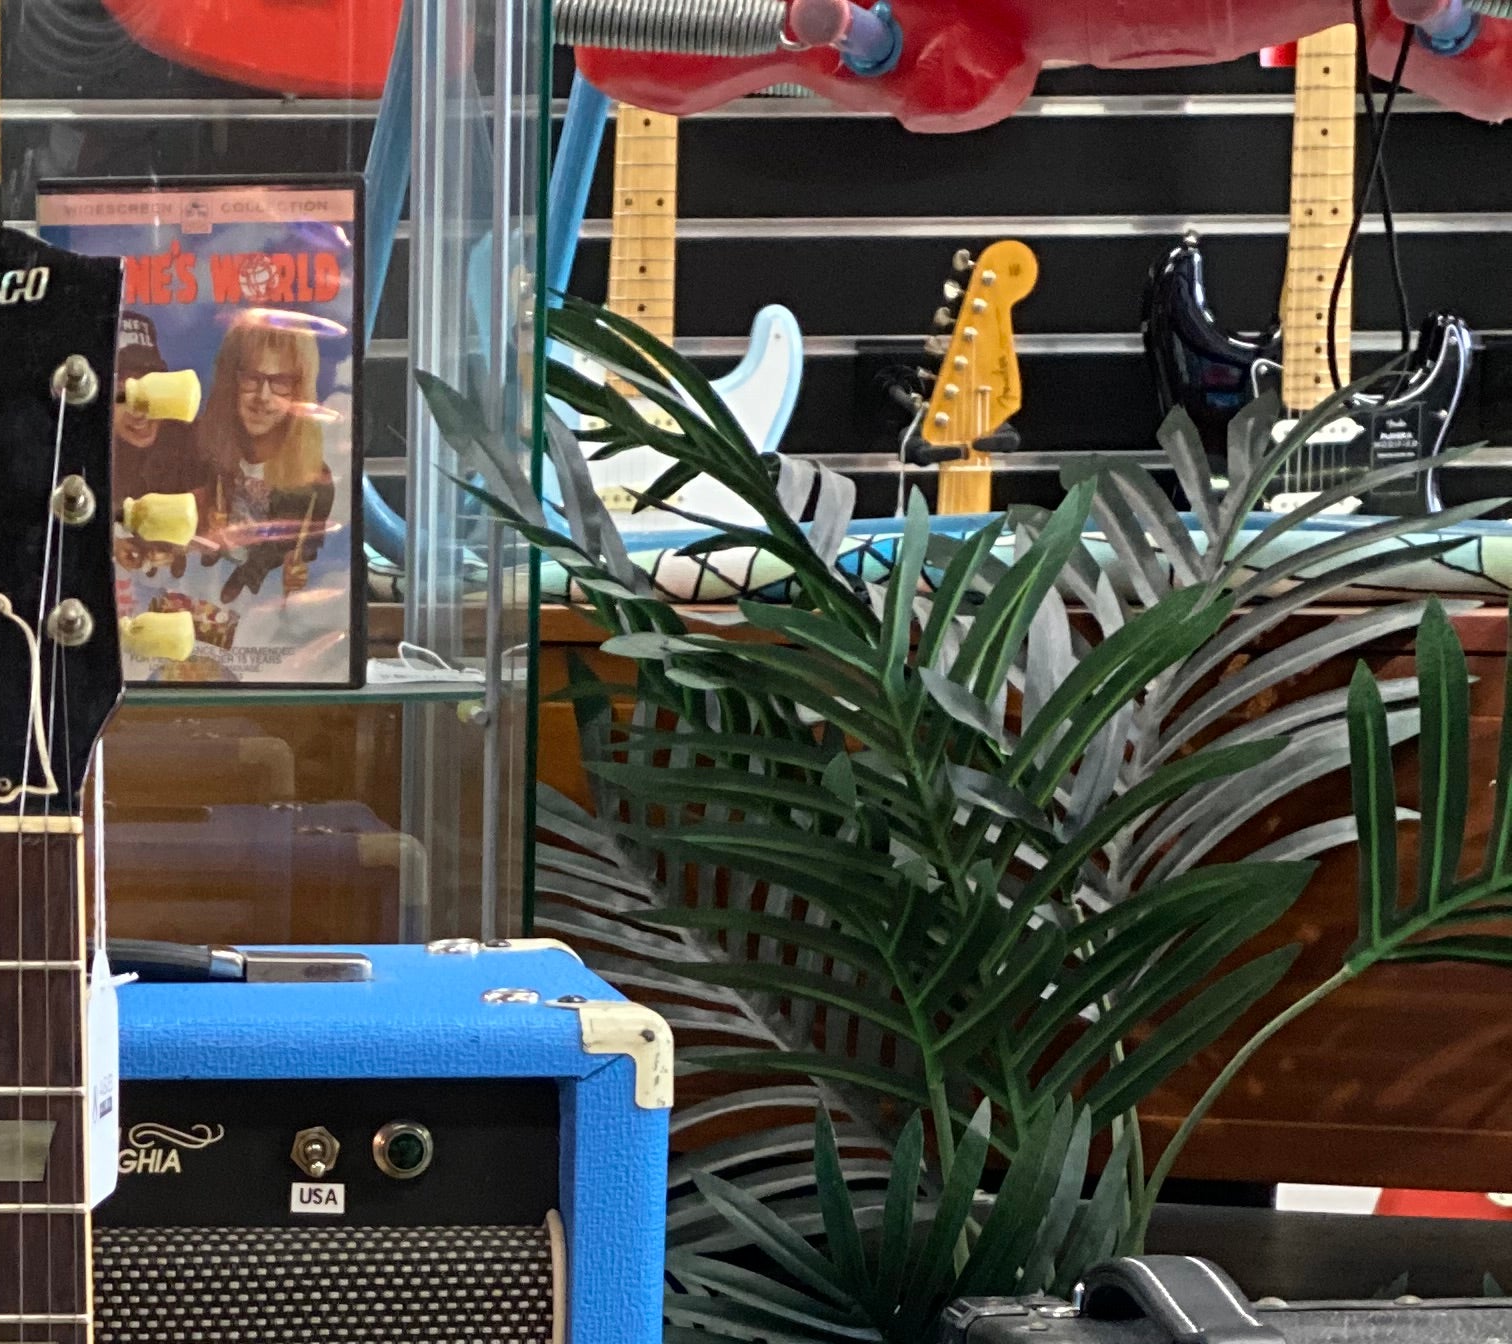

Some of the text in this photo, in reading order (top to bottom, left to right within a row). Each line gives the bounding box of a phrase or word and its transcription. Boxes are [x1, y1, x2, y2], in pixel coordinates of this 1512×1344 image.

[64, 199, 329, 217] WIDESCREEN COLLTION
[125, 240, 198, 305] NE'S
[118, 1148, 182, 1174] GHIA
[299, 1187, 338, 1205] USA
